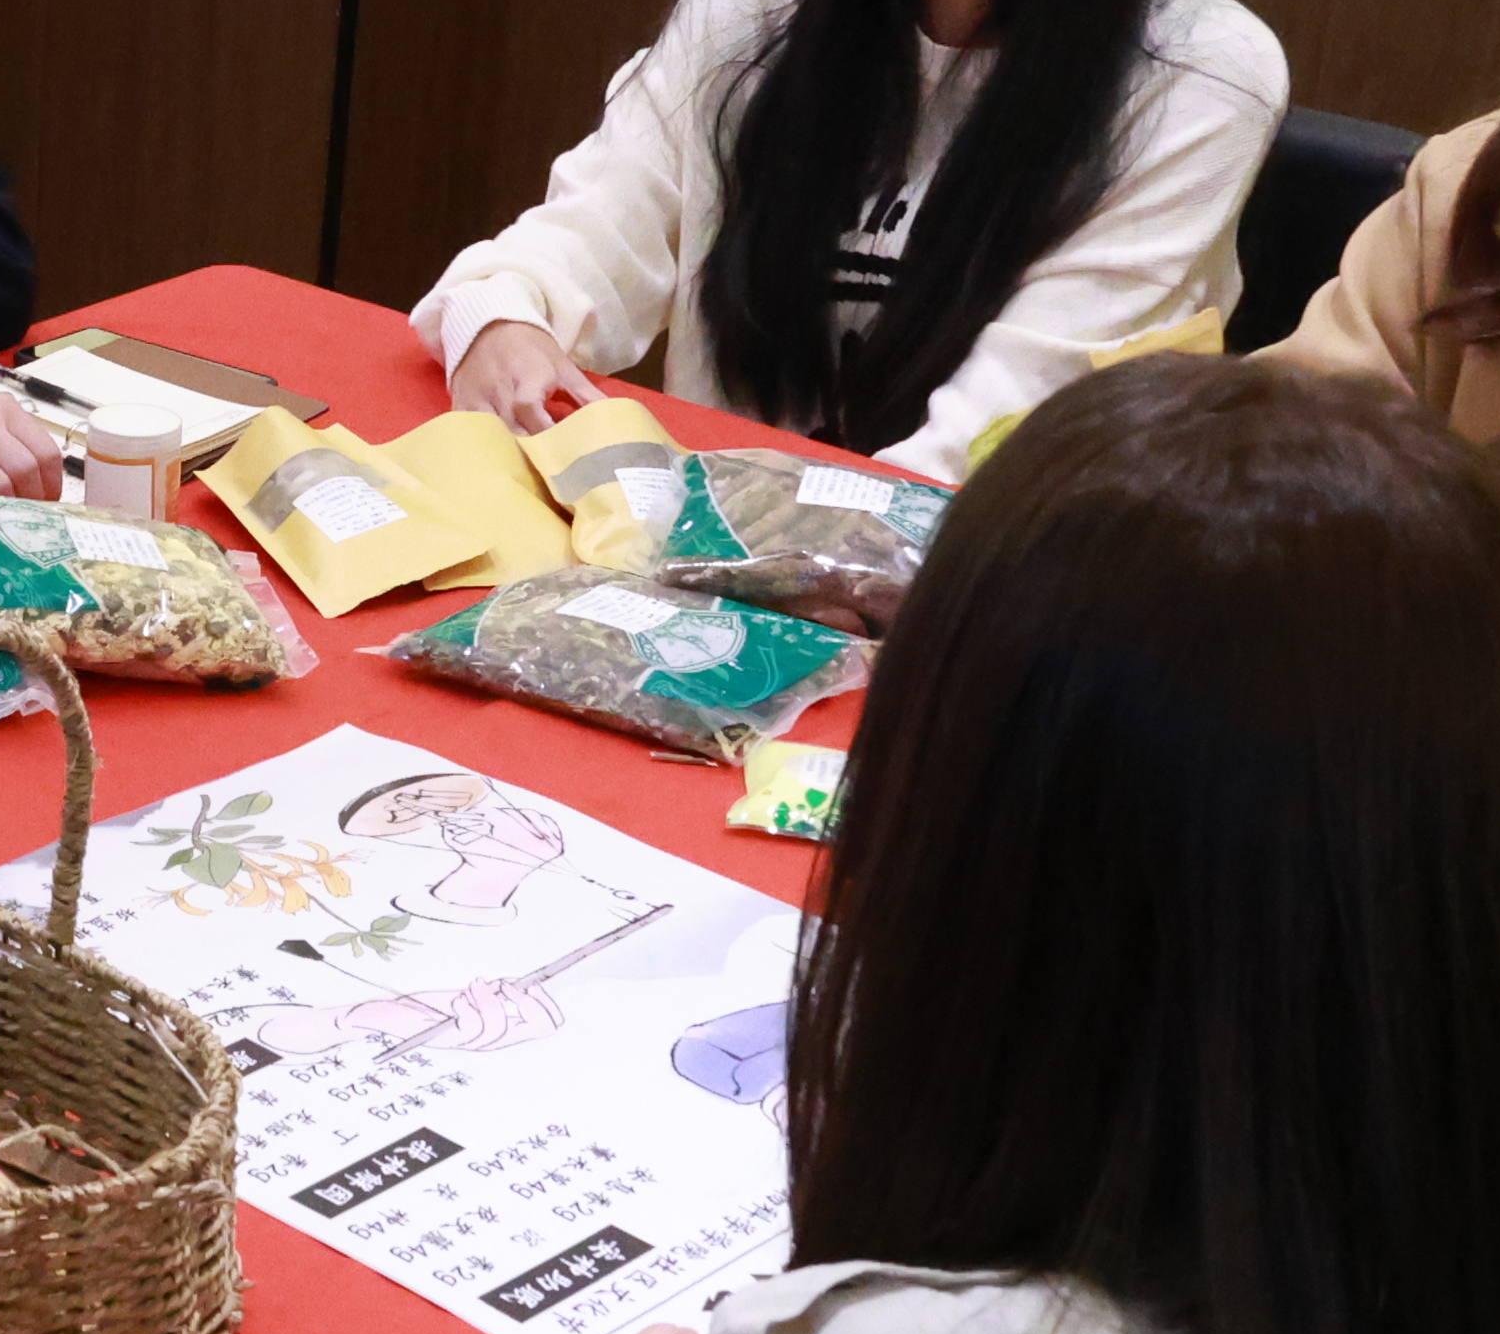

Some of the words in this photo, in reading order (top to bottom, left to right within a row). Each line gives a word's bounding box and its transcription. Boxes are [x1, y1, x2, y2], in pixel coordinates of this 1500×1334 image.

[367, 1070, 470, 1121] 迷迭香2g
[314, 1138, 437, 1204] 提神解困
[466, 1123, 570, 1177] 合欢花4g
[551, 1167, 654, 1222] 安息香2g
[499, 1239, 625, 1308] 安神助眠
